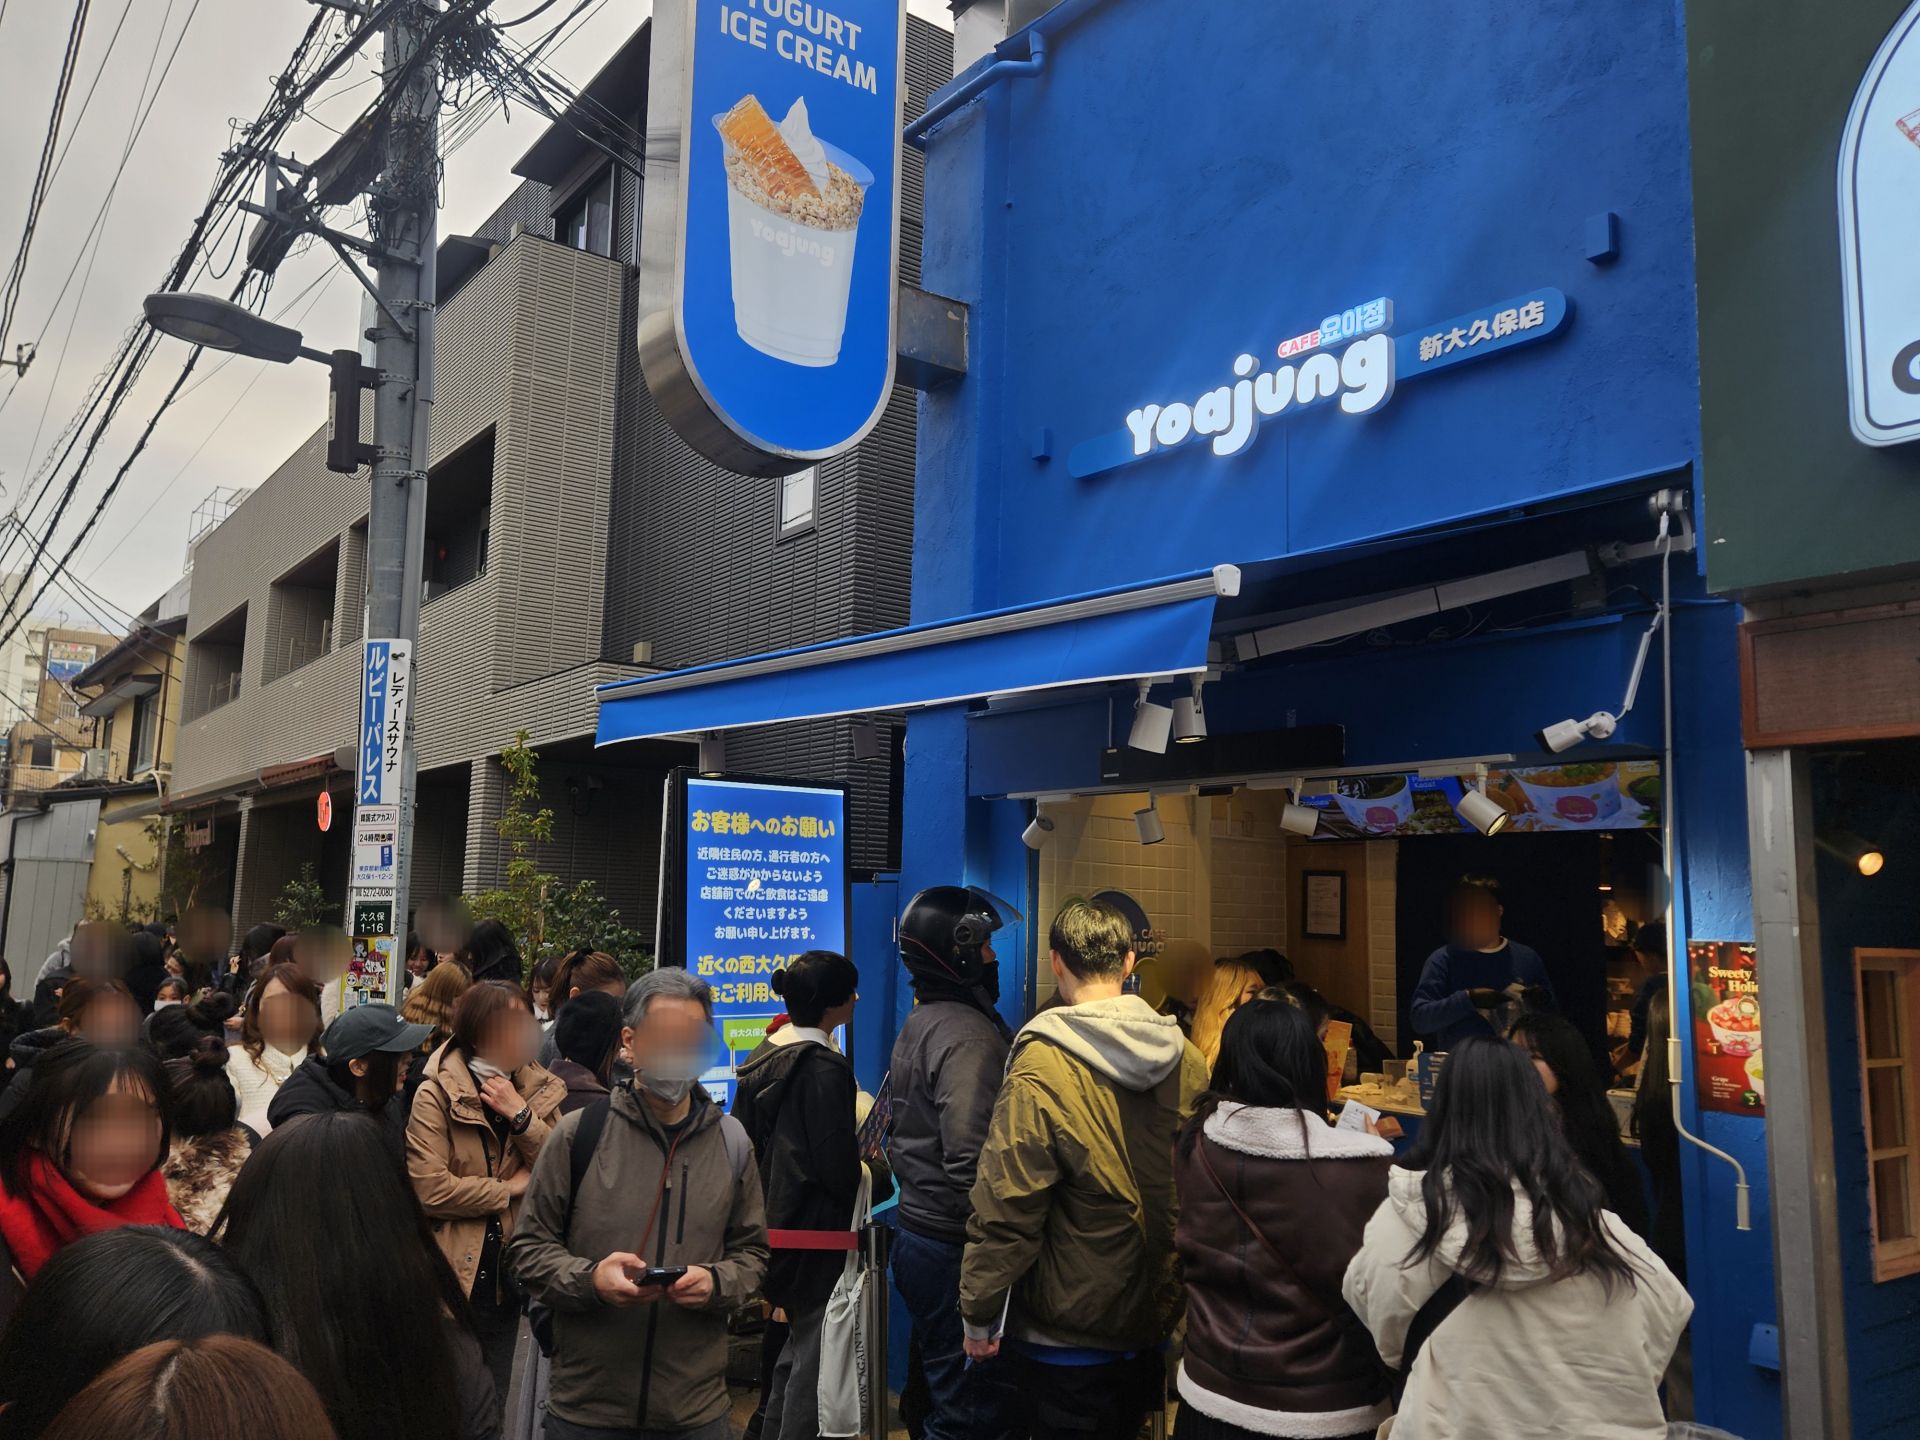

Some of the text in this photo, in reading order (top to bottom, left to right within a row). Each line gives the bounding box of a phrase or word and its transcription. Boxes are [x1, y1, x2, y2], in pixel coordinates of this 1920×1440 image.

[720, 5, 877, 95] ICE CREAM
[750, 219, 835, 267] Yoajung
[1278, 297, 1387, 357] CAFE 요아정
[1419, 300, 1546, 362] 新大久保店
[1125, 333, 1390, 457] Yoajung
[363, 646, 386, 800] ルビーパレス
[386, 672, 405, 773] レディースサウナ
[691, 809, 836, 839] お客様へのお願い
[697, 847, 831, 864] 近隣住民の方、通行者の方へ
[706, 867, 823, 883] ご迷惑がかからないよう
[700, 886, 829, 903] 店舗前でのご飲食はご遠慮
[360, 911, 385, 922] 大久保
[723, 906, 808, 920] くださいますよう
[361, 923, 384, 933] 1-16
[714, 926, 816, 941] お願い申し上げます。
[1708, 966, 1752, 982] Sweety
